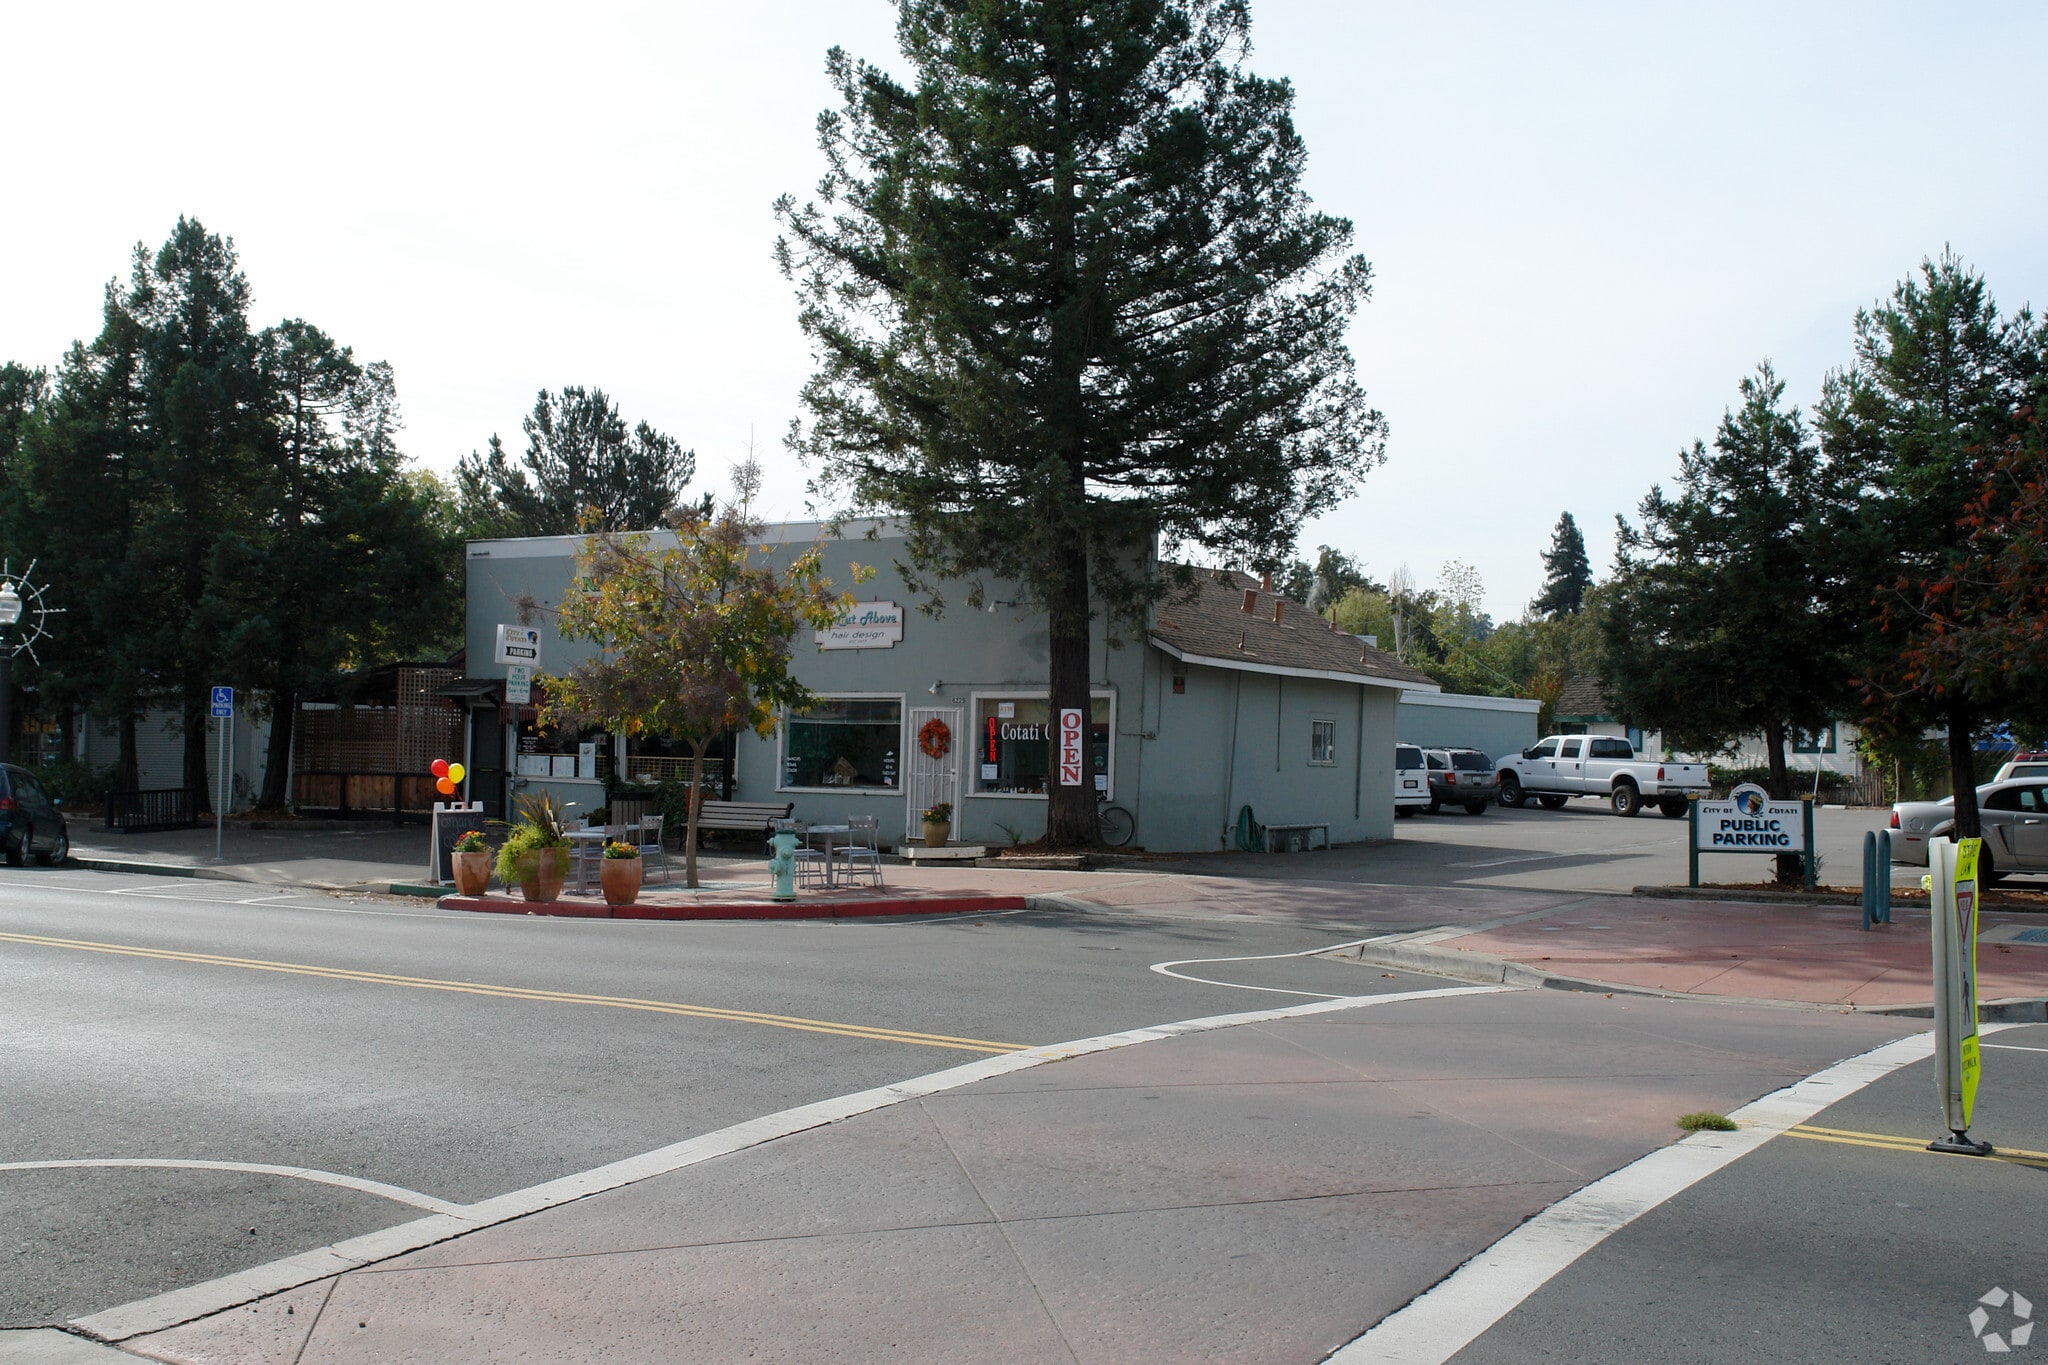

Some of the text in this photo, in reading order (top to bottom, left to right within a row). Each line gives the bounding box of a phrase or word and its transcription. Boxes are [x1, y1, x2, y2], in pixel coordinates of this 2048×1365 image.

[860, 610, 897, 626] Above
[831, 630, 885, 639] hair design
[509, 647, 532, 657] PARKING
[512, 673, 526, 681] HOUR
[508, 680, 529, 688] PARKING
[1001, 722, 1039, 740] Cotati
[988, 717, 997, 762] OPEN
[1062, 713, 1081, 782] OPEN
[1720, 820, 1780, 832] PUBLIC
[1713, 833, 1790, 846] PARKING
